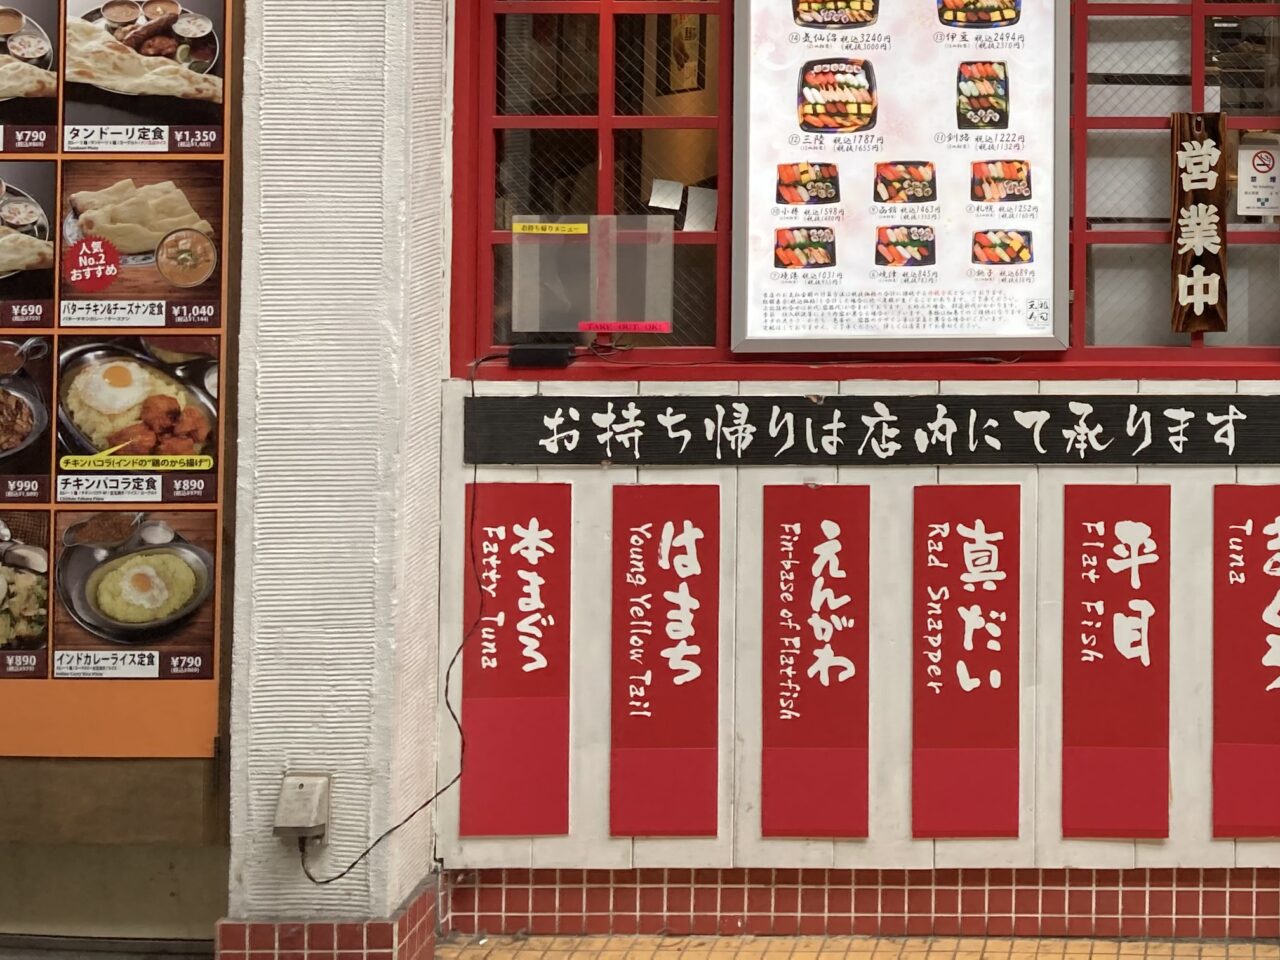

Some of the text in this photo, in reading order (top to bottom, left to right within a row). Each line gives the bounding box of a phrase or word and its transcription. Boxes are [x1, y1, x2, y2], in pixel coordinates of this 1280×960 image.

[15, 130, 47, 142] ¥790
[68, 126, 165, 140] タンドーリ定食
[174, 130, 217, 143] ¥1,350
[1176, 138, 1222, 316] 営業中
[78, 254, 106, 267] No.2
[79, 241, 104, 255] 人気
[70, 266, 118, 282] おすすめ
[11, 304, 43, 317] ¥690
[171, 305, 214, 317] ¥1,040
[537, 401, 1249, 460] お持ち帰りは店内にて承ります
[7, 480, 38, 491] ¥990
[173, 479, 205, 490] ¥890
[1228, 518, 1254, 585] Tuna
[480, 525, 506, 670] Fatty Tuna
[510, 516, 555, 673] 本まぐろ
[658, 519, 705, 686] はまち
[806, 519, 856, 687] えんがわ
[955, 518, 1008, 692] 真だい
[1080, 520, 1105, 662] Flat Fish
[1106, 519, 1160, 668] 平目
[625, 522, 653, 718] Young Yellow Tail
[779, 609, 801, 631] of
[922, 585, 950, 695] Snapper
[56, 652, 156, 666] インドカレーライス定食
[170, 656, 202, 667] ¥790
[779, 636, 801, 721] Flatfish
